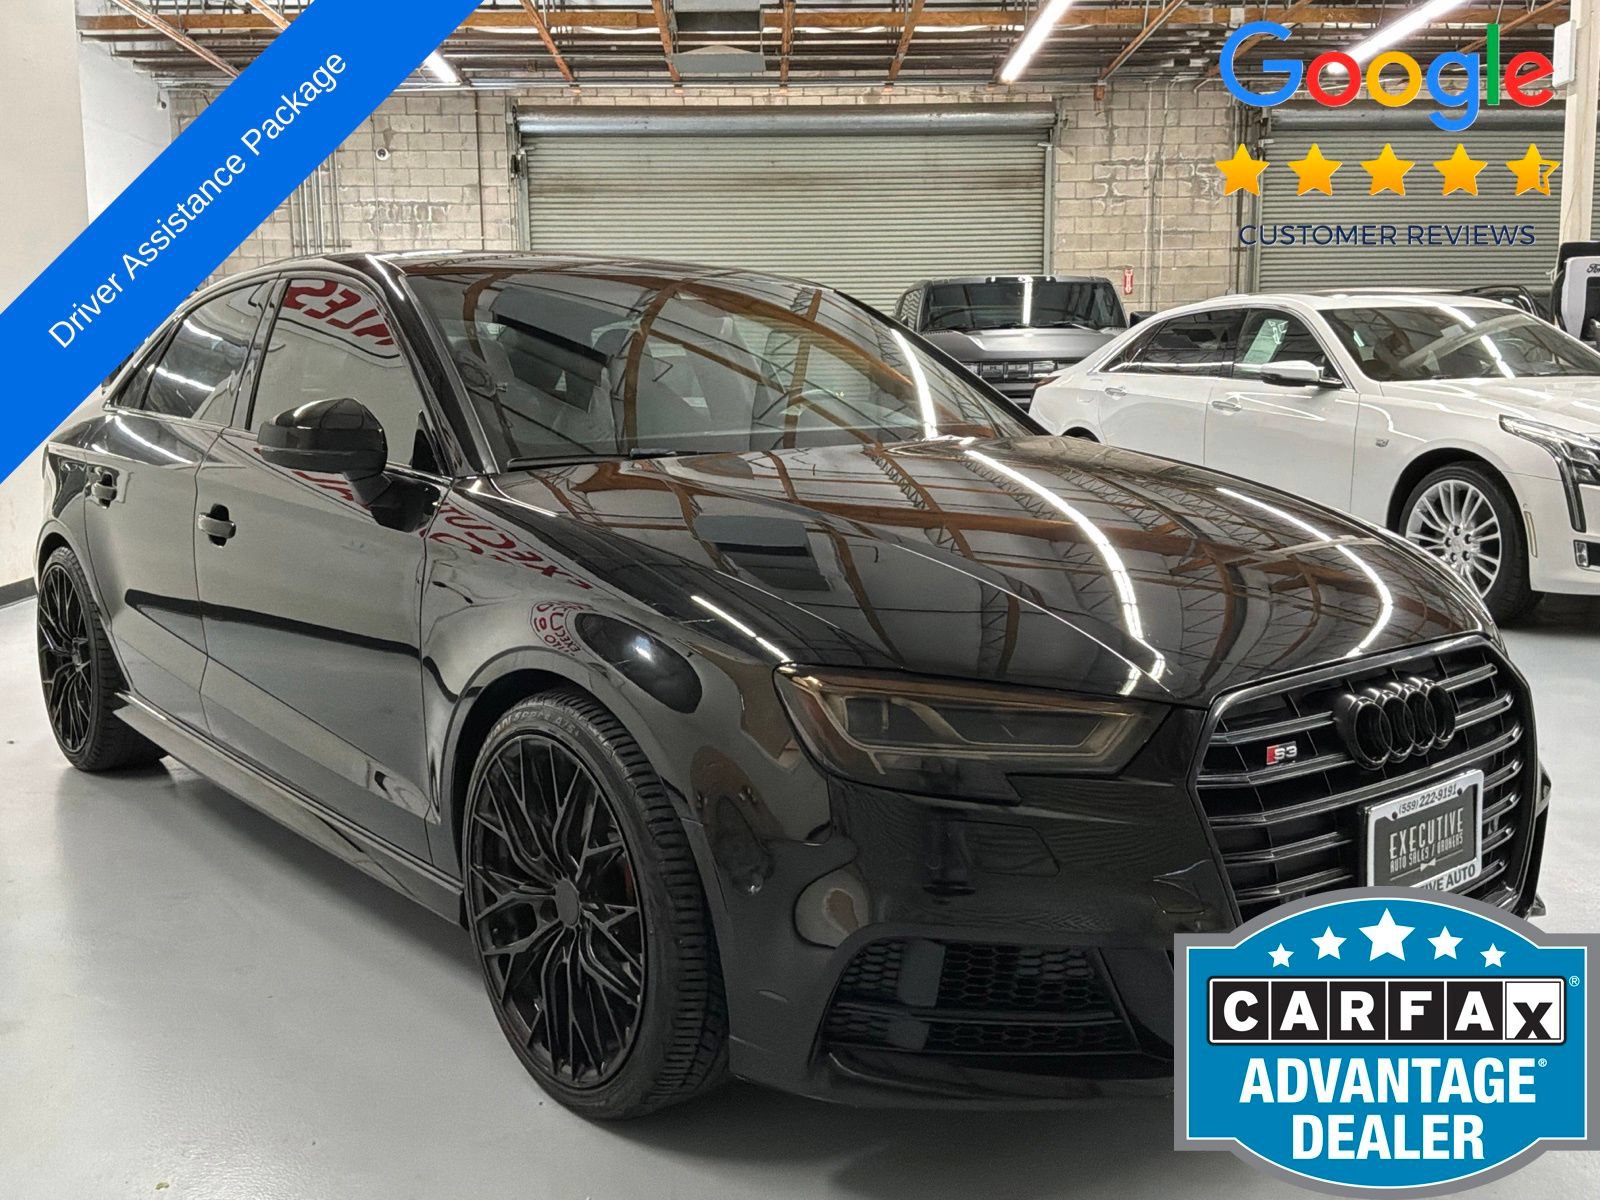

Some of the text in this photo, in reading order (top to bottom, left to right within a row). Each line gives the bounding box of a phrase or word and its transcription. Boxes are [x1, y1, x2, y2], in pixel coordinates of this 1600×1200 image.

[1274, 745, 1298, 761] S3
[1419, 783, 1457, 808] 222-9191
[1389, 807, 1464, 860] EXECUTIVE
[1390, 855, 1407, 873] AUTO
[1408, 846, 1430, 867] SALES
[1445, 863, 1476, 889] AUTO
